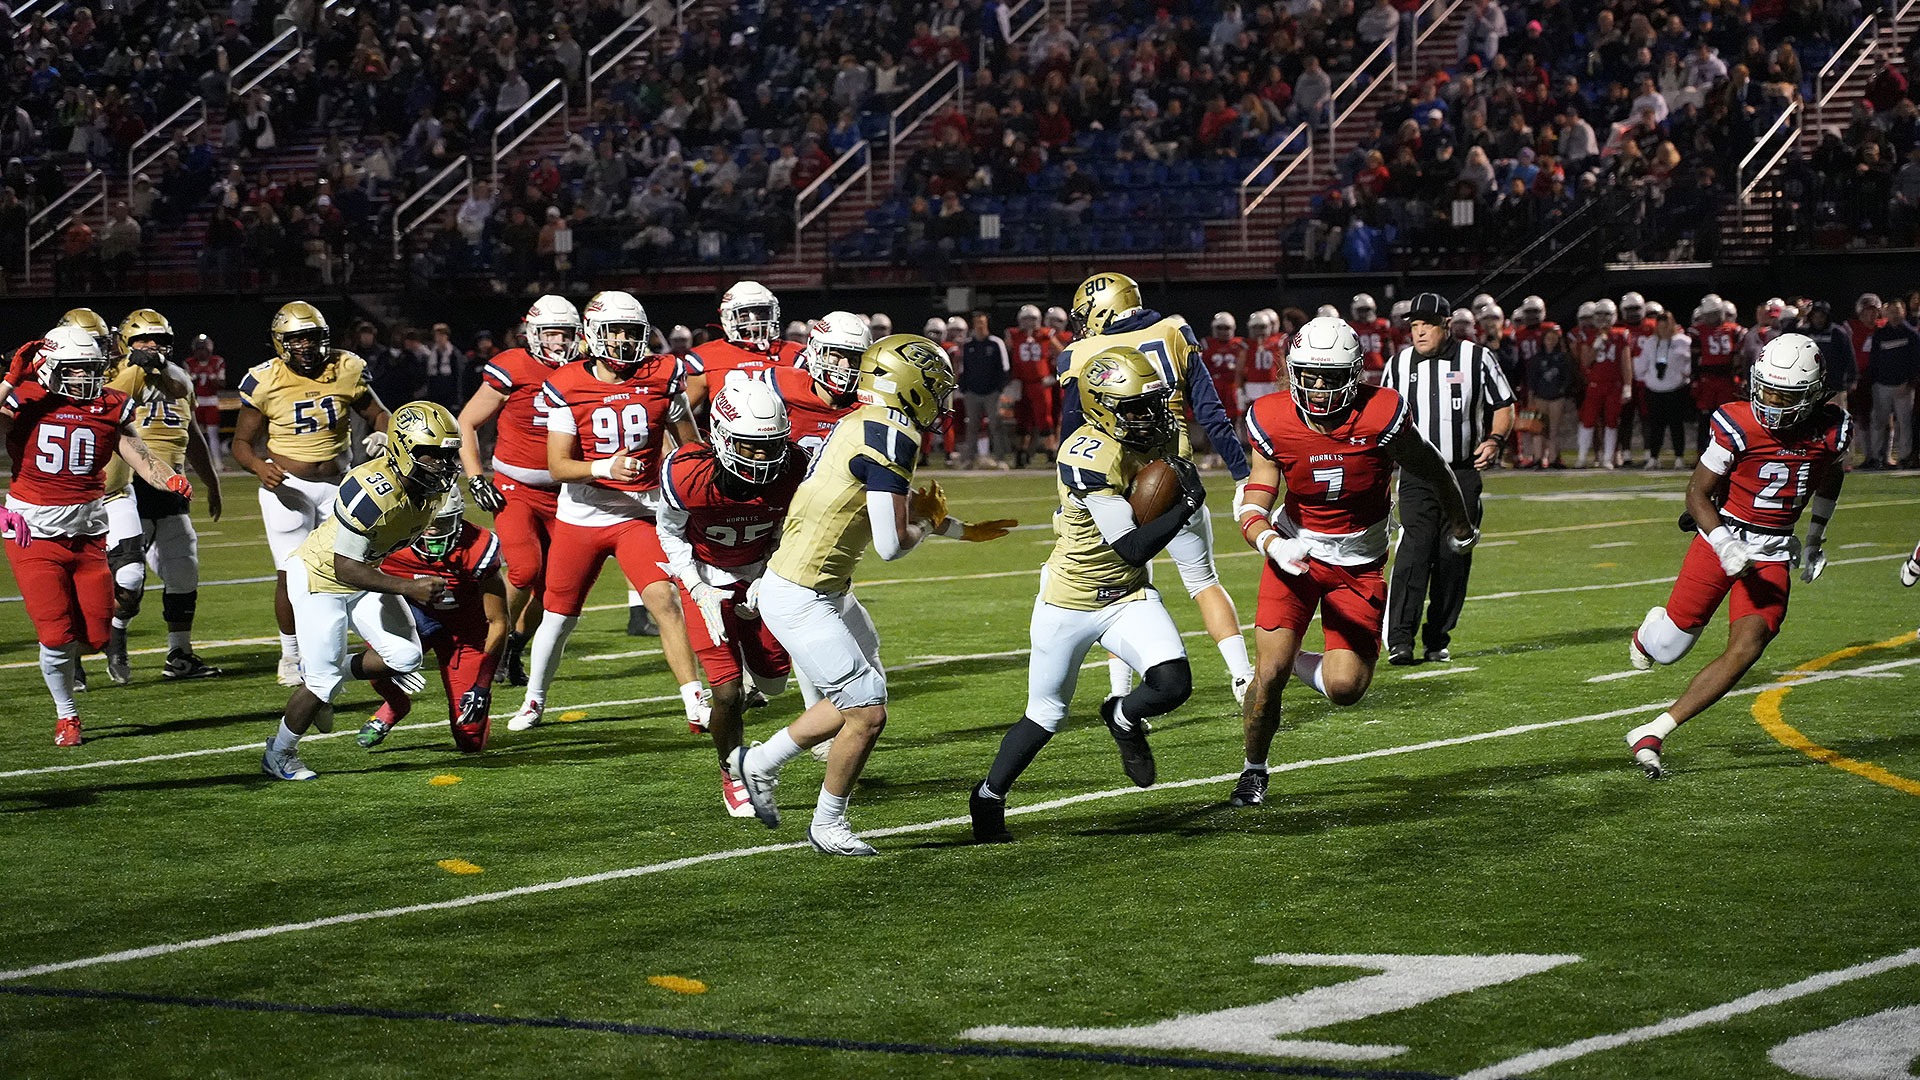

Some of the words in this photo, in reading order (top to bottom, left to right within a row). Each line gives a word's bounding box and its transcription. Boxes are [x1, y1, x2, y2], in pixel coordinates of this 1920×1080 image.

[1085, 277, 1107, 297] 80
[1410, 373, 1417, 383] S
[294, 396, 338, 435] 51
[1452, 398, 1461, 410] U
[591, 403, 649, 454] 98
[35, 423, 95, 475] 50
[1069, 436, 1102, 461] 22
[1310, 454, 1343, 464] HORNETS
[366, 472, 394, 497] 39
[1312, 466, 1344, 501] 7
[1752, 462, 1810, 510] 21
[726, 515, 759, 523] HORNETS
